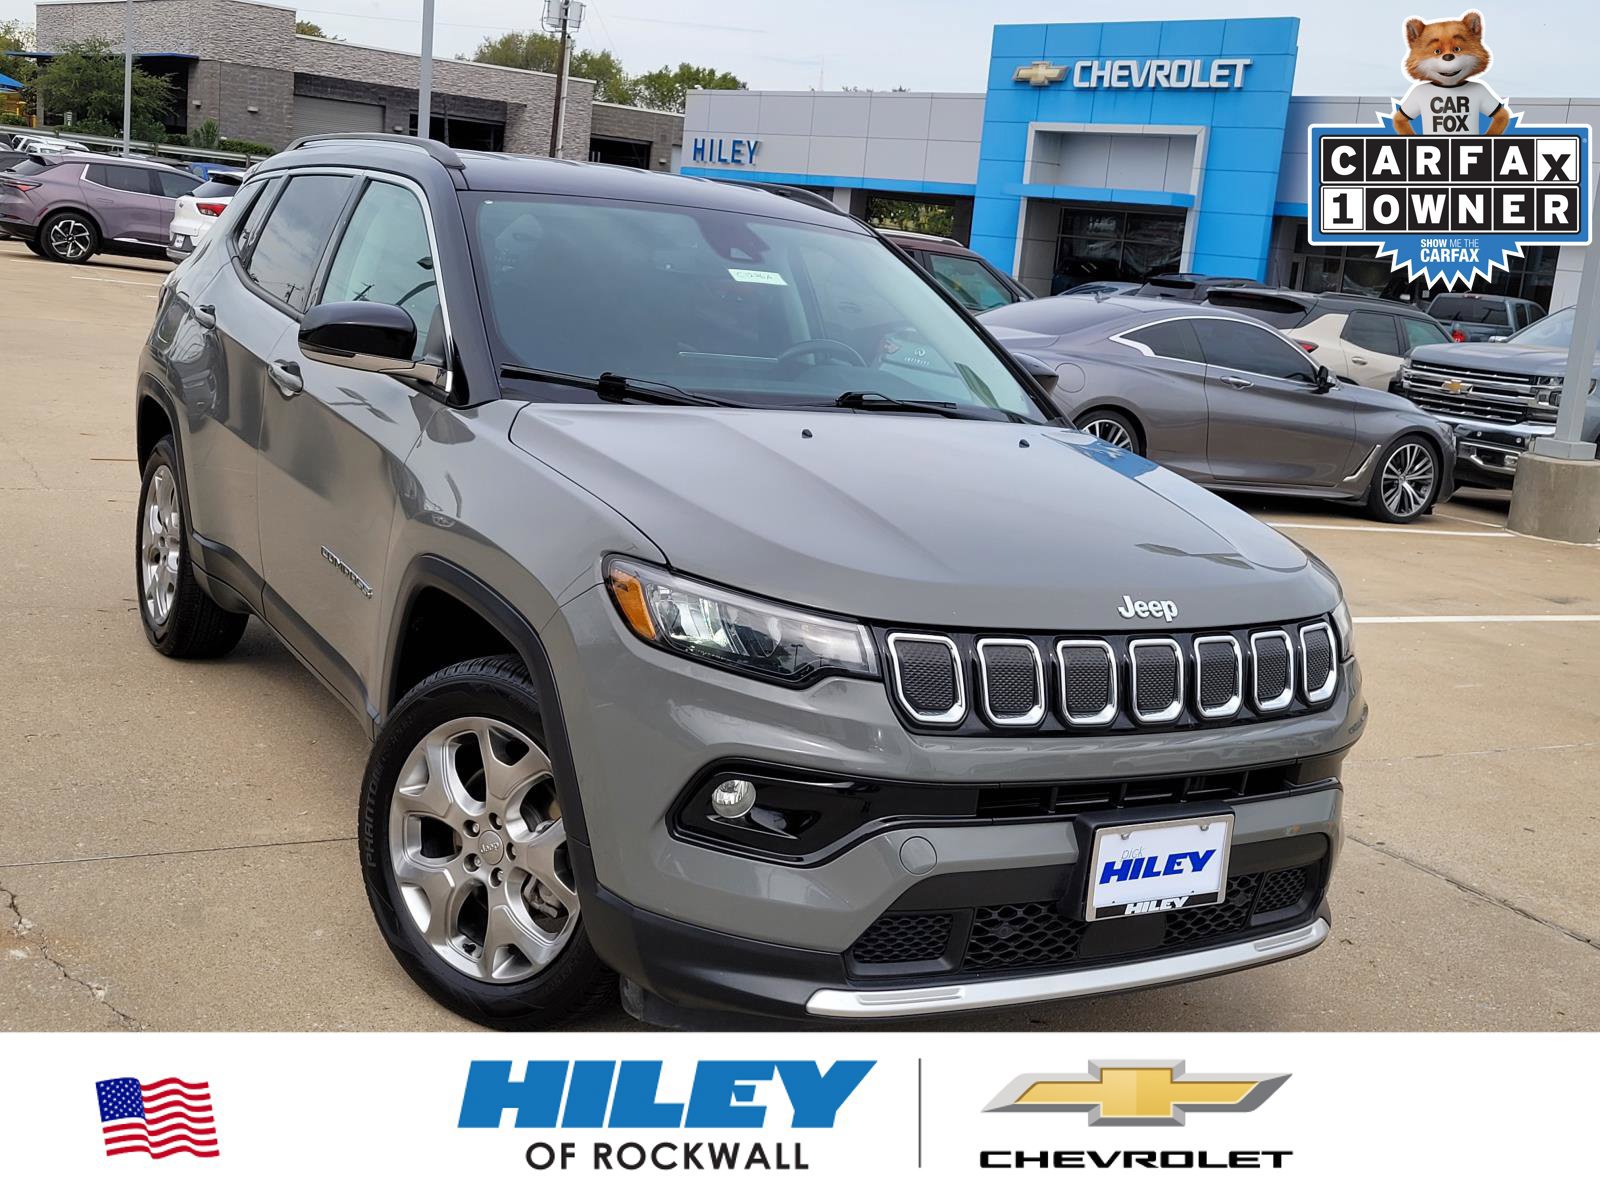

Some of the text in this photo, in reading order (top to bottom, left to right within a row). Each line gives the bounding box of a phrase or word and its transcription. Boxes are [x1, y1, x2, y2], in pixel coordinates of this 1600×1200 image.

[1073, 59, 1252, 88] CHEVROLET
[693, 138, 759, 164] HILEY
[1117, 595, 1178, 623] Jeep
[1099, 849, 1217, 885] HILEY
[1124, 896, 1190, 915] HILEY
